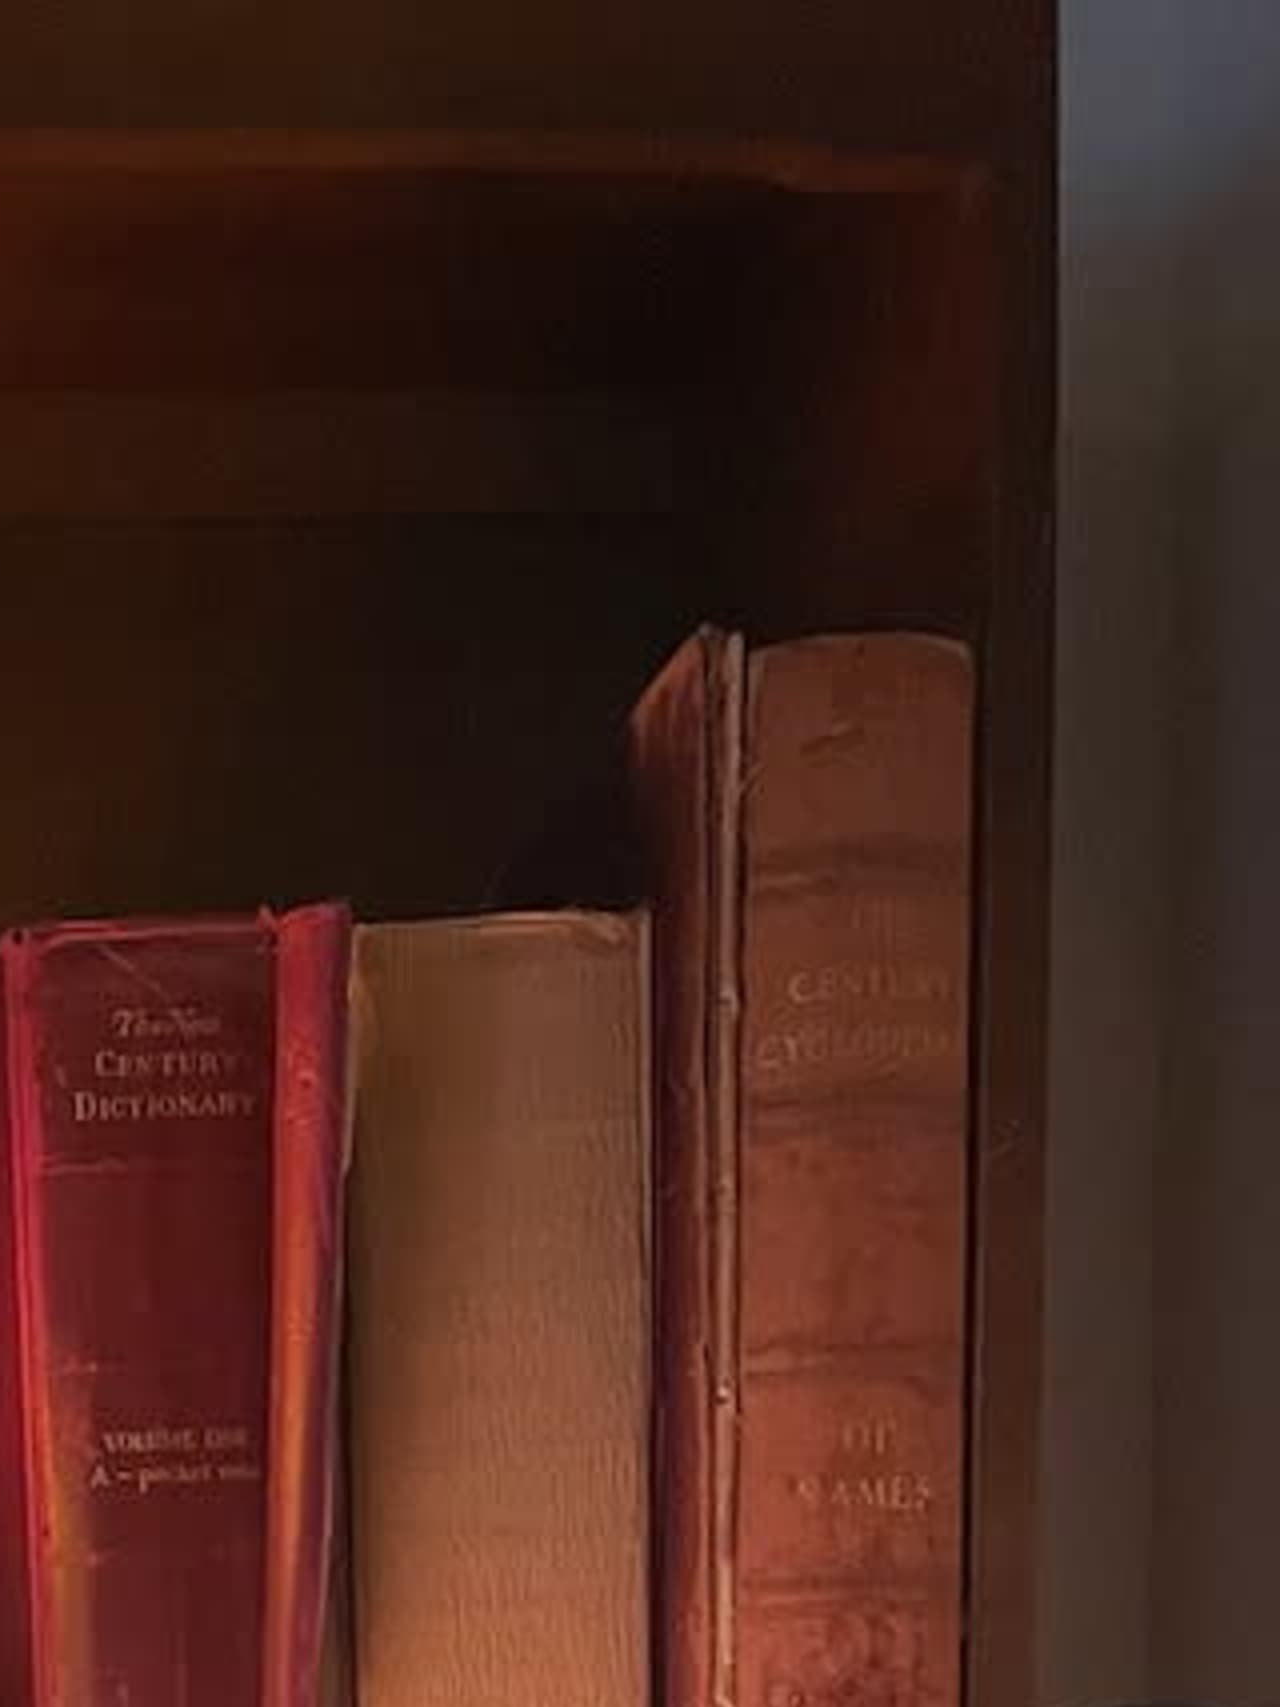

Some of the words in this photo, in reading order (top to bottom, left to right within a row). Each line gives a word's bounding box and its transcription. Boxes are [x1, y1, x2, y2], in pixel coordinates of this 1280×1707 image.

[94, 1049, 242, 1078] CENTURY
[73, 1090, 257, 1122] DICTIONARY
[103, 1427, 199, 1453] VOLUME
